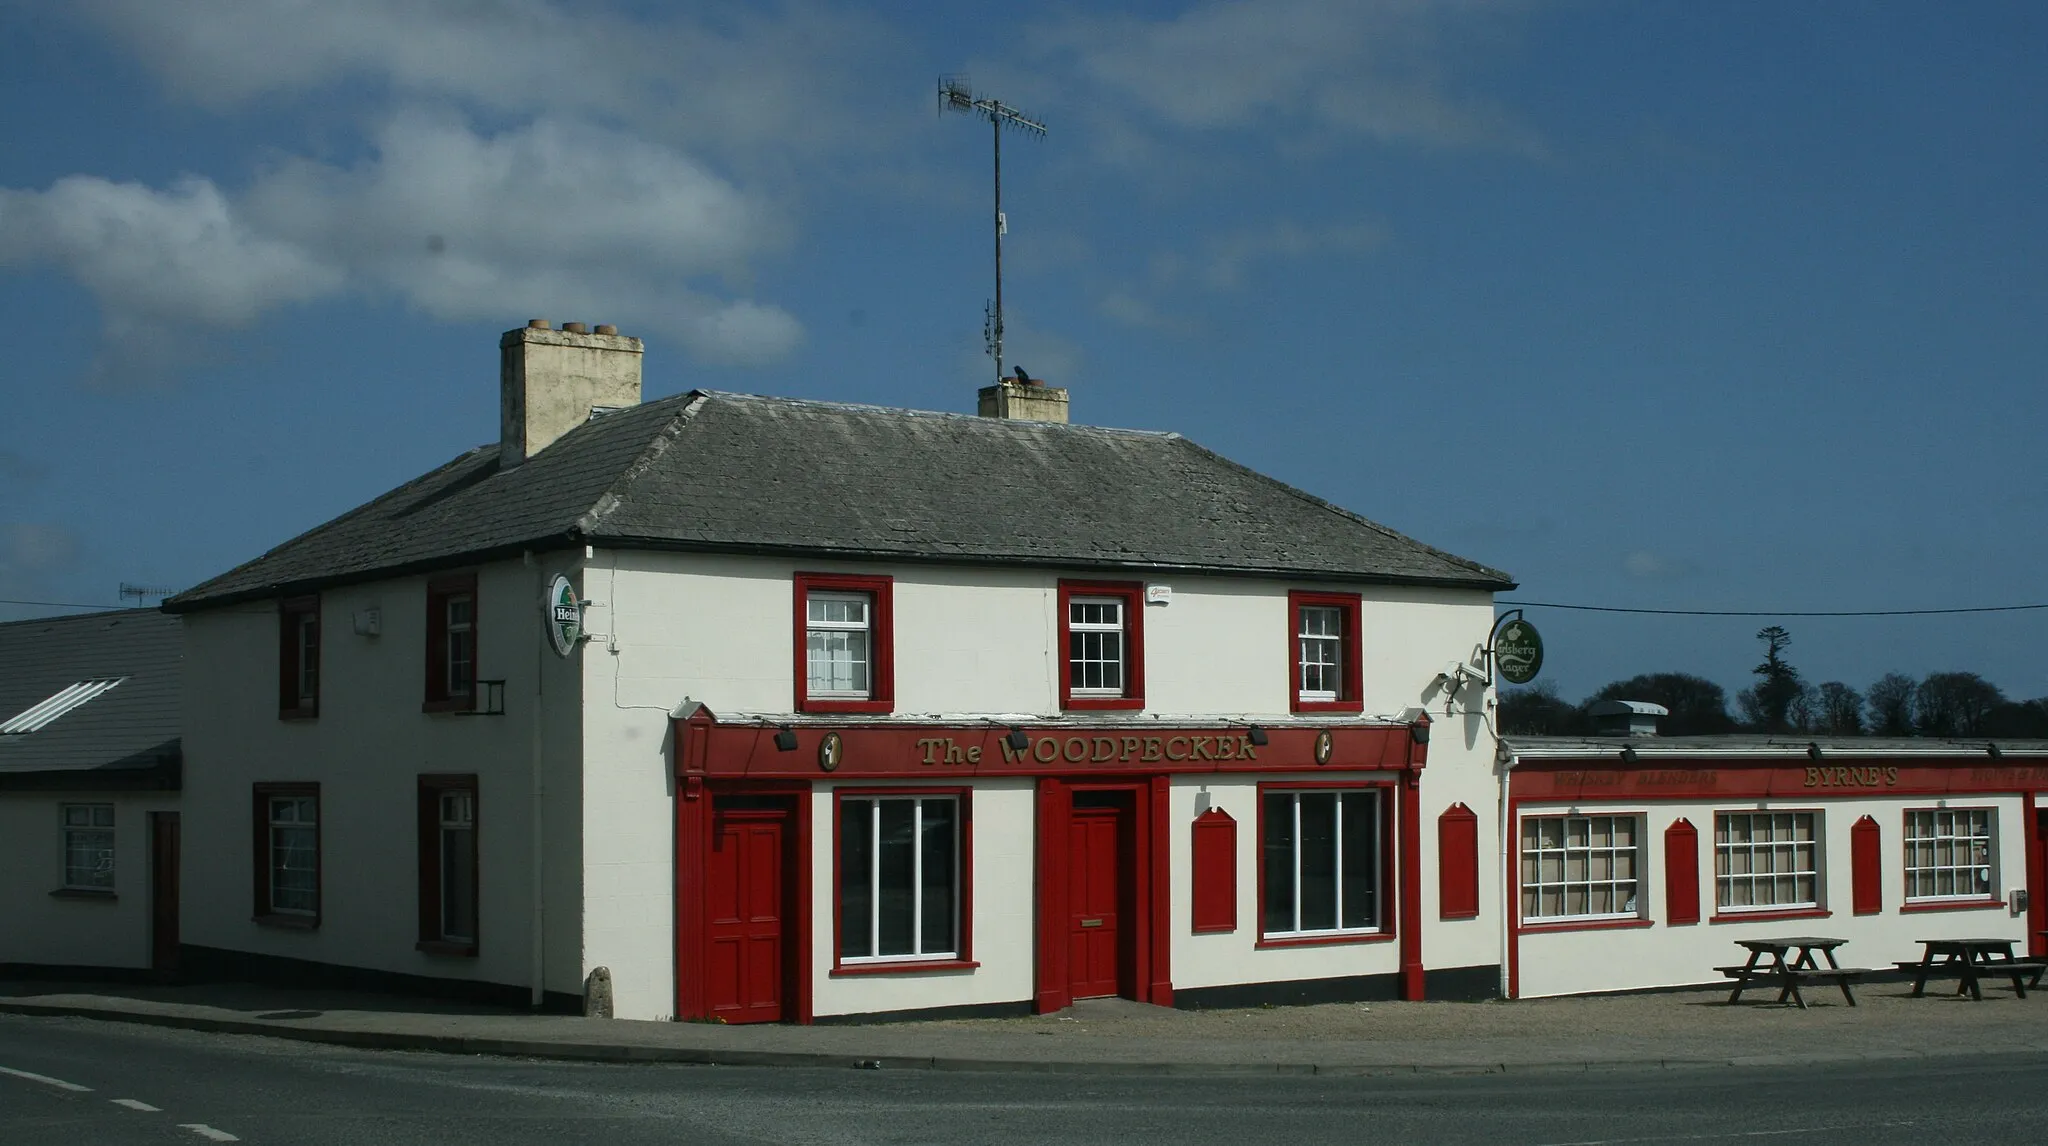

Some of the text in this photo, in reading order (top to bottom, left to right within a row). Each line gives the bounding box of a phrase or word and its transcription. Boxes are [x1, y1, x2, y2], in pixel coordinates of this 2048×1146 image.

[1500, 660, 1531, 677] Lager
[916, 736, 1258, 764] The WOODPECKER
[1804, 766, 1898, 787] BYRNE'S
